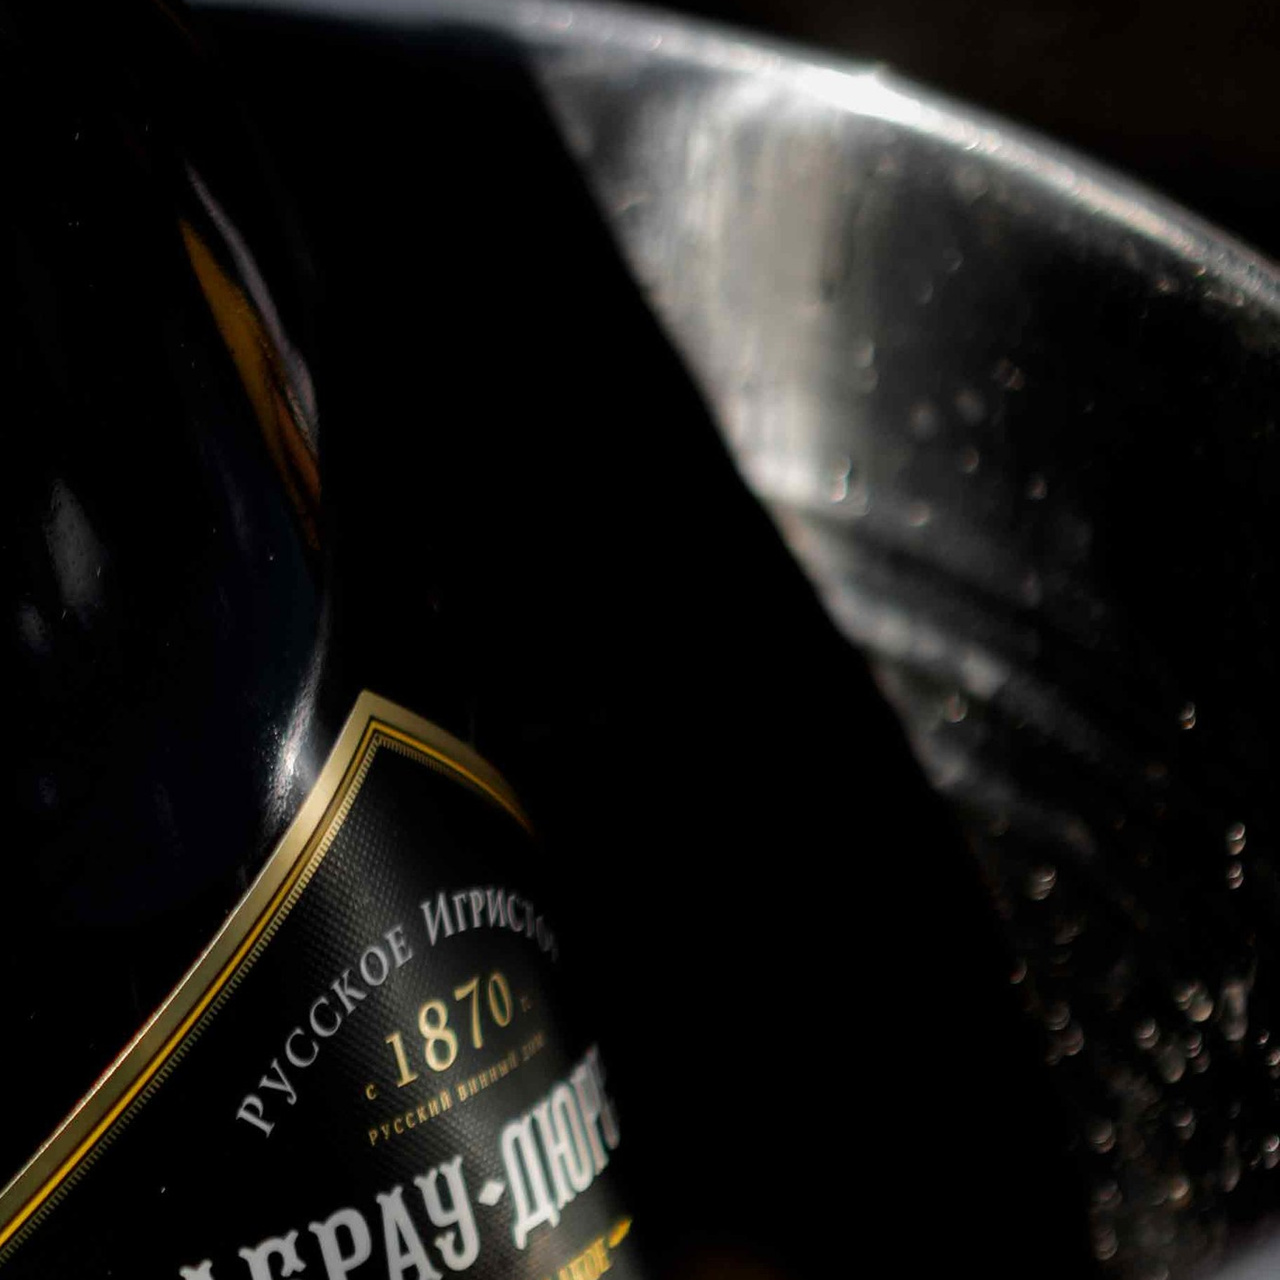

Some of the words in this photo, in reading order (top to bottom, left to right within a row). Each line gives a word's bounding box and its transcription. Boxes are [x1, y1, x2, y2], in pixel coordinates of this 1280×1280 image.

[236, 924, 414, 1140] РУССКОЕ
[420, 886, 560, 965] ИГРИСТО
[384, 970, 515, 1089] 1870
[367, 1087, 453, 1148] РУССКИЙ
